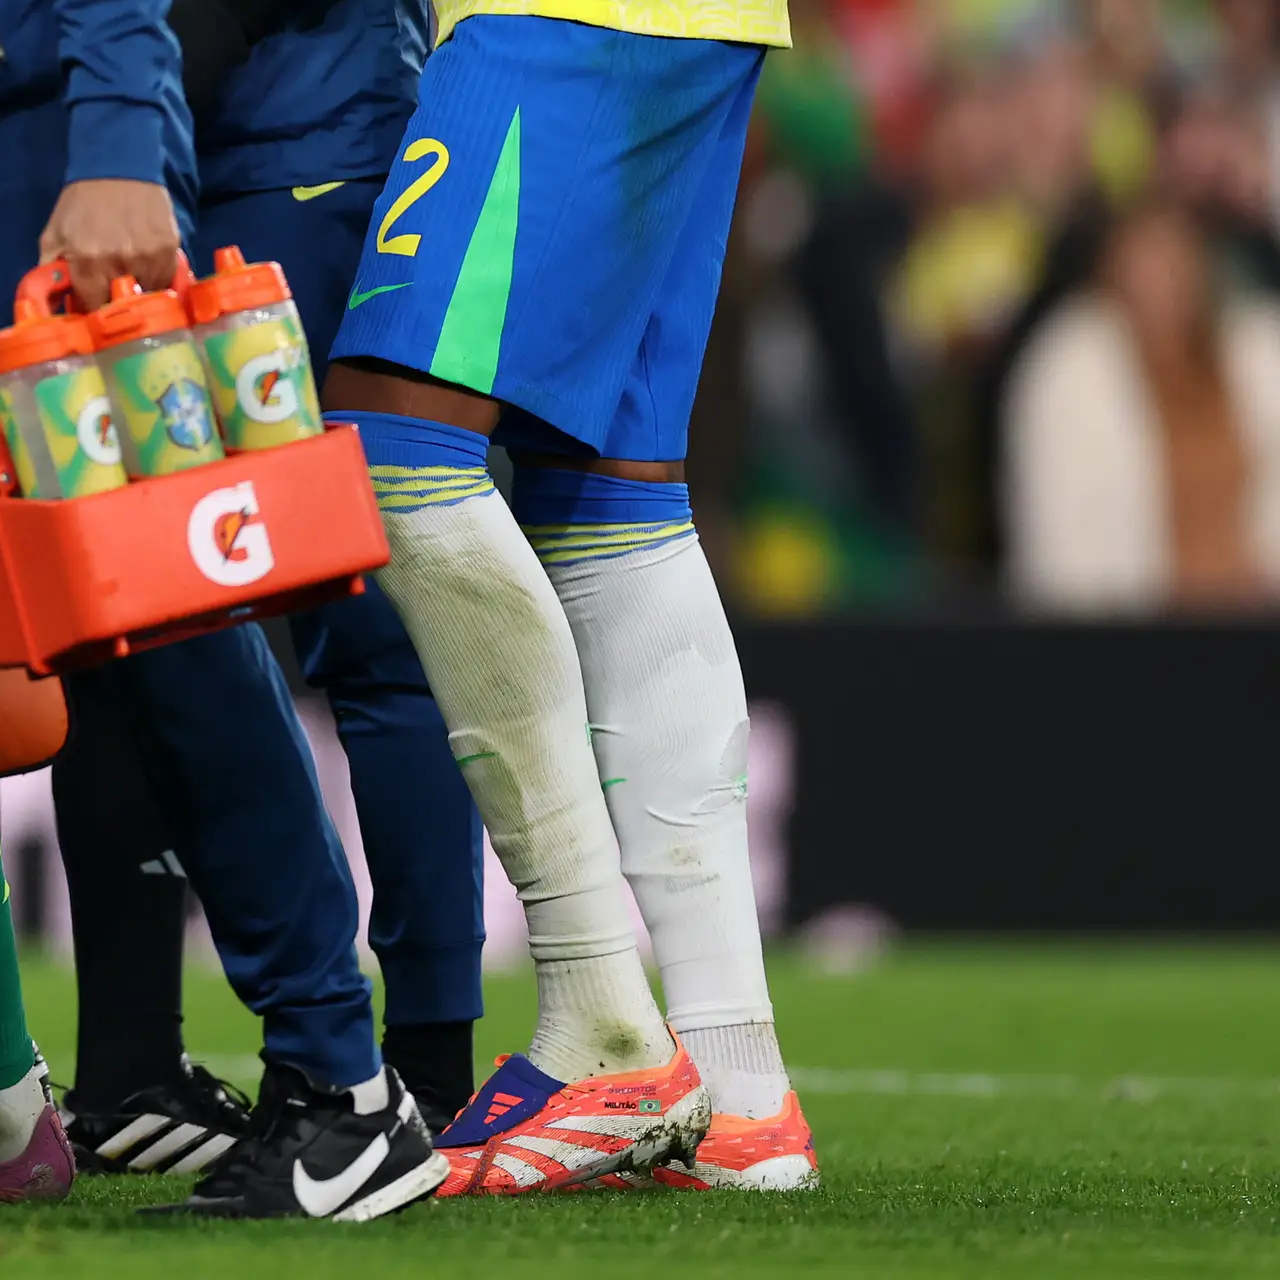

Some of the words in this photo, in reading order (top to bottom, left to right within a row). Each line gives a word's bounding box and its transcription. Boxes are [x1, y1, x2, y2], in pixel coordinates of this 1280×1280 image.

[376, 137, 450, 257] 2
[236, 353, 298, 424] G
[187, 480, 274, 586] G
